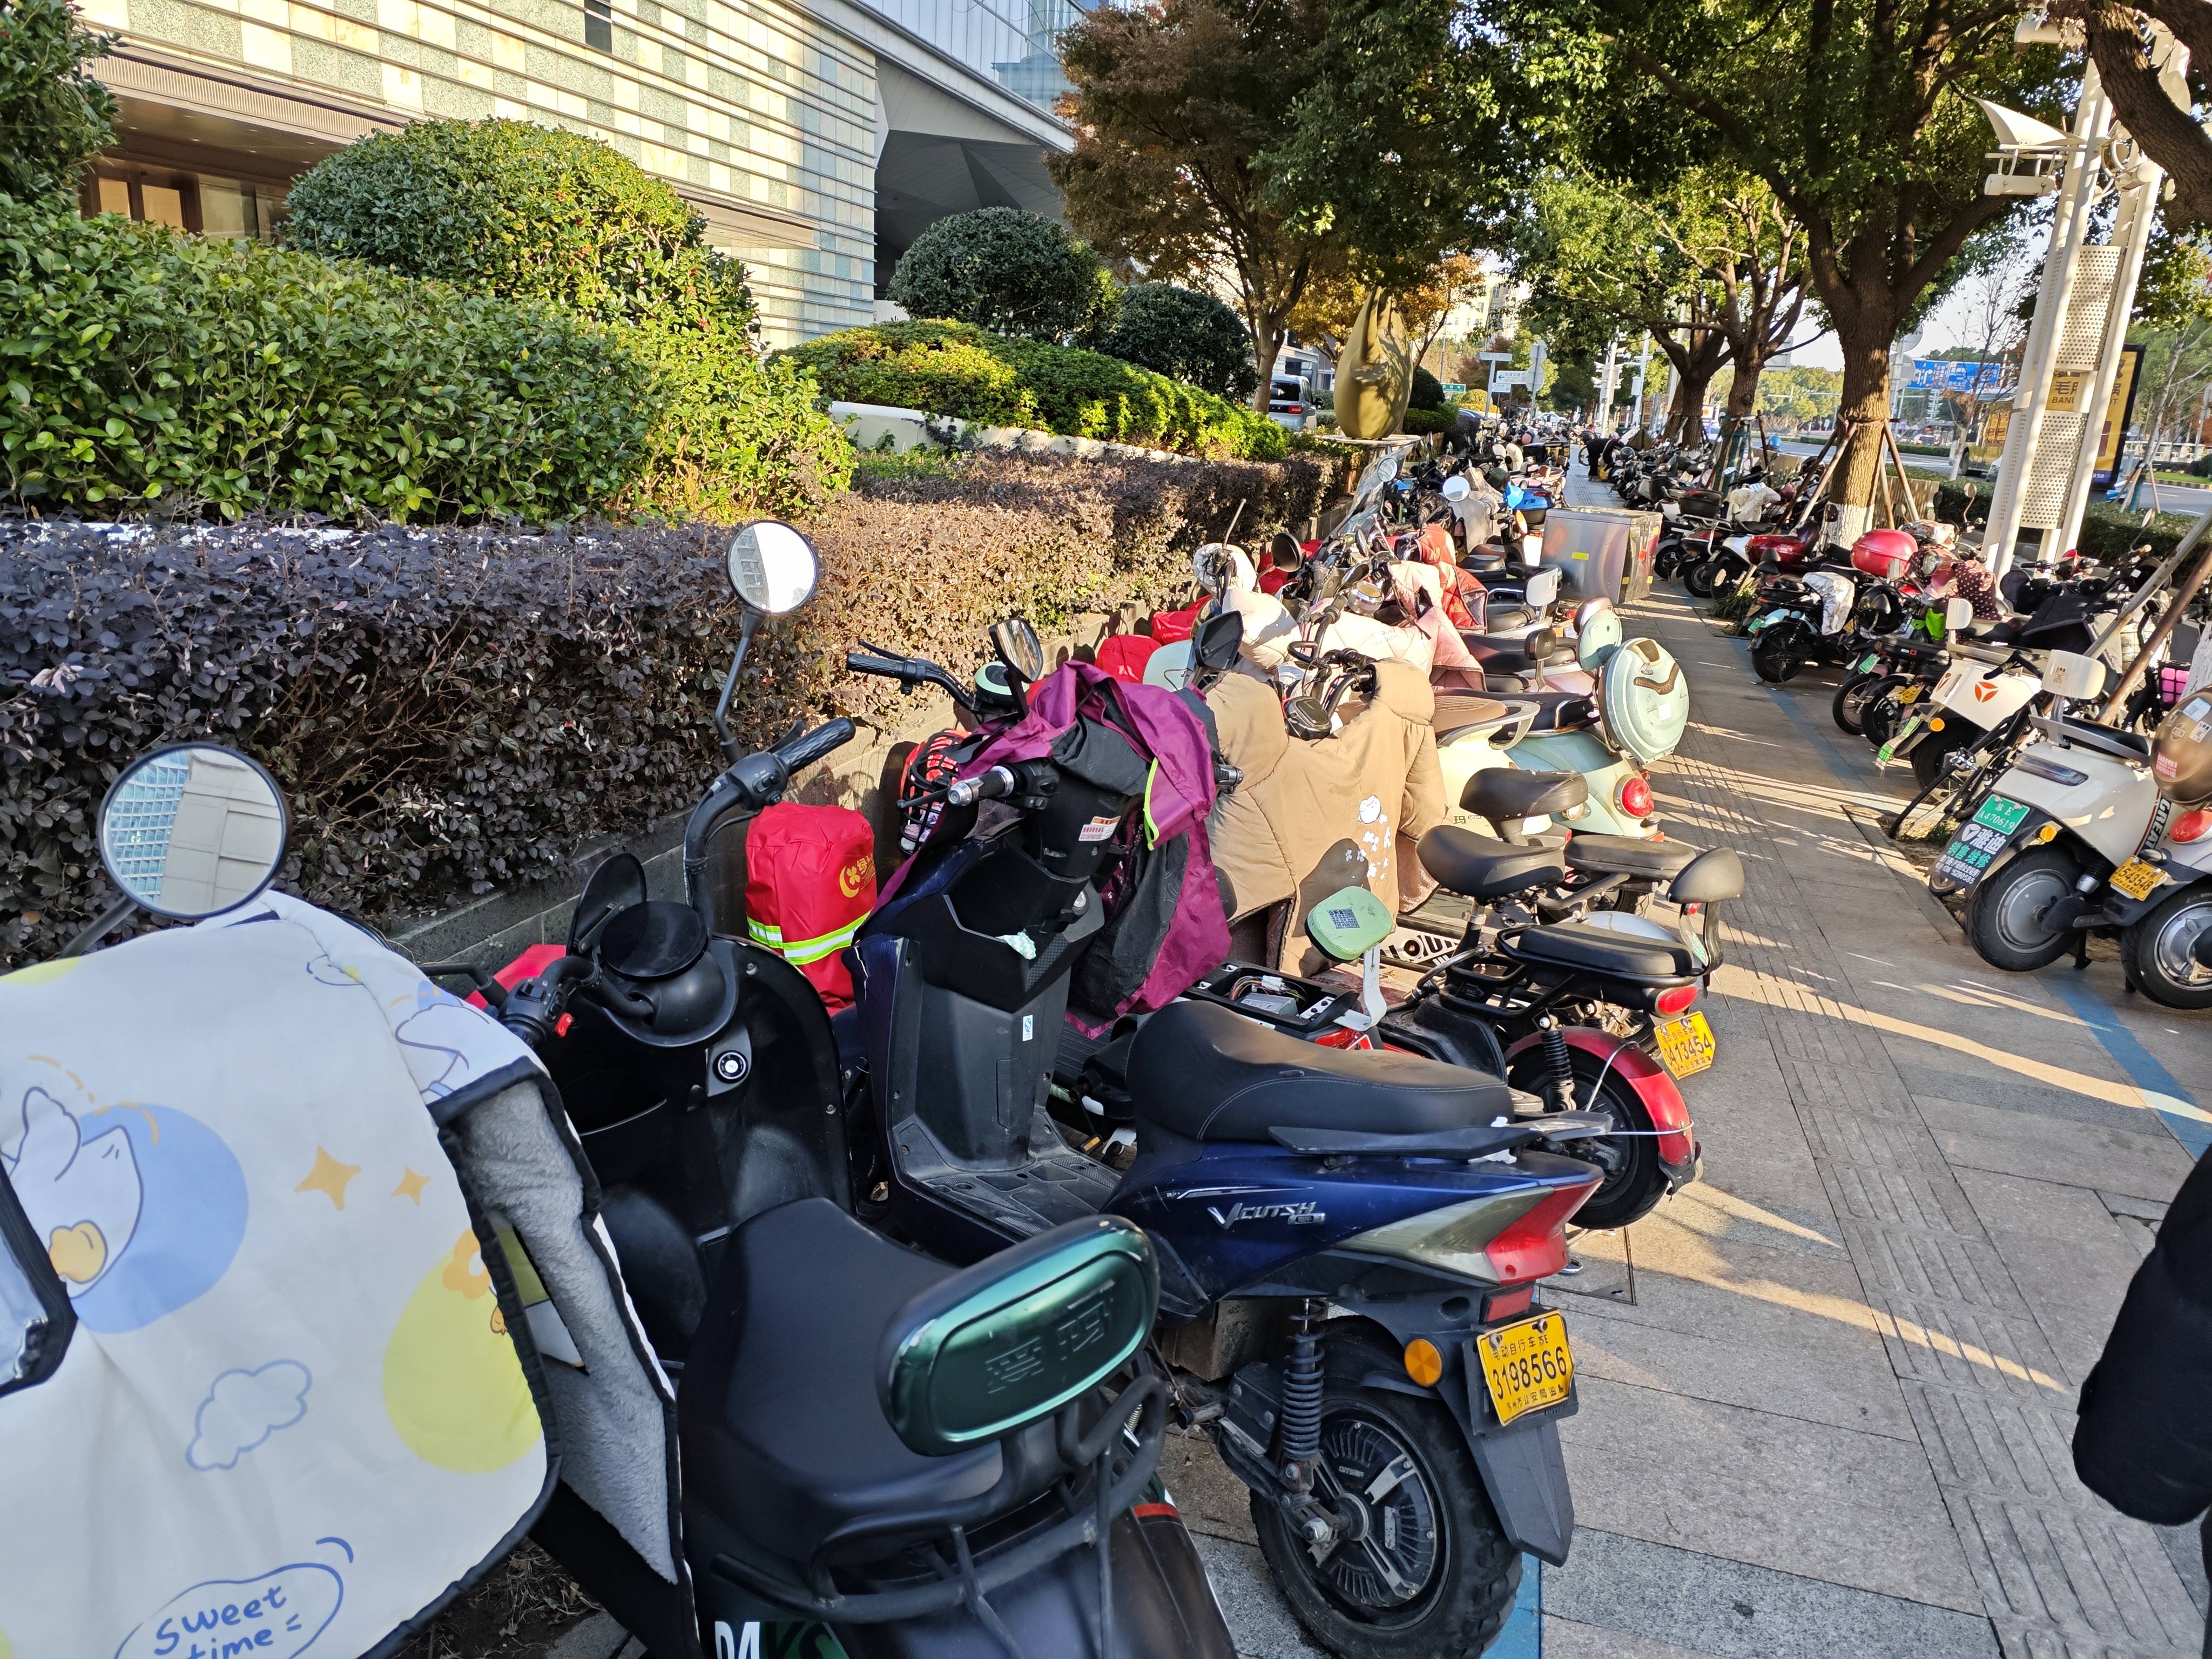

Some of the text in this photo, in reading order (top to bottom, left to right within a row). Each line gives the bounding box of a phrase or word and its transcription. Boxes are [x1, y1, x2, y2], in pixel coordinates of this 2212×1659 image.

[1978, 810, 2015, 830] A470619
[2004, 806, 2014, 816] E
[1947, 840, 1992, 868] 销售 维修
[1969, 828, 2007, 855] 雅迪
[1493, 1346, 1567, 1400] 3198566
[154, 1586, 287, 1655] sweet
